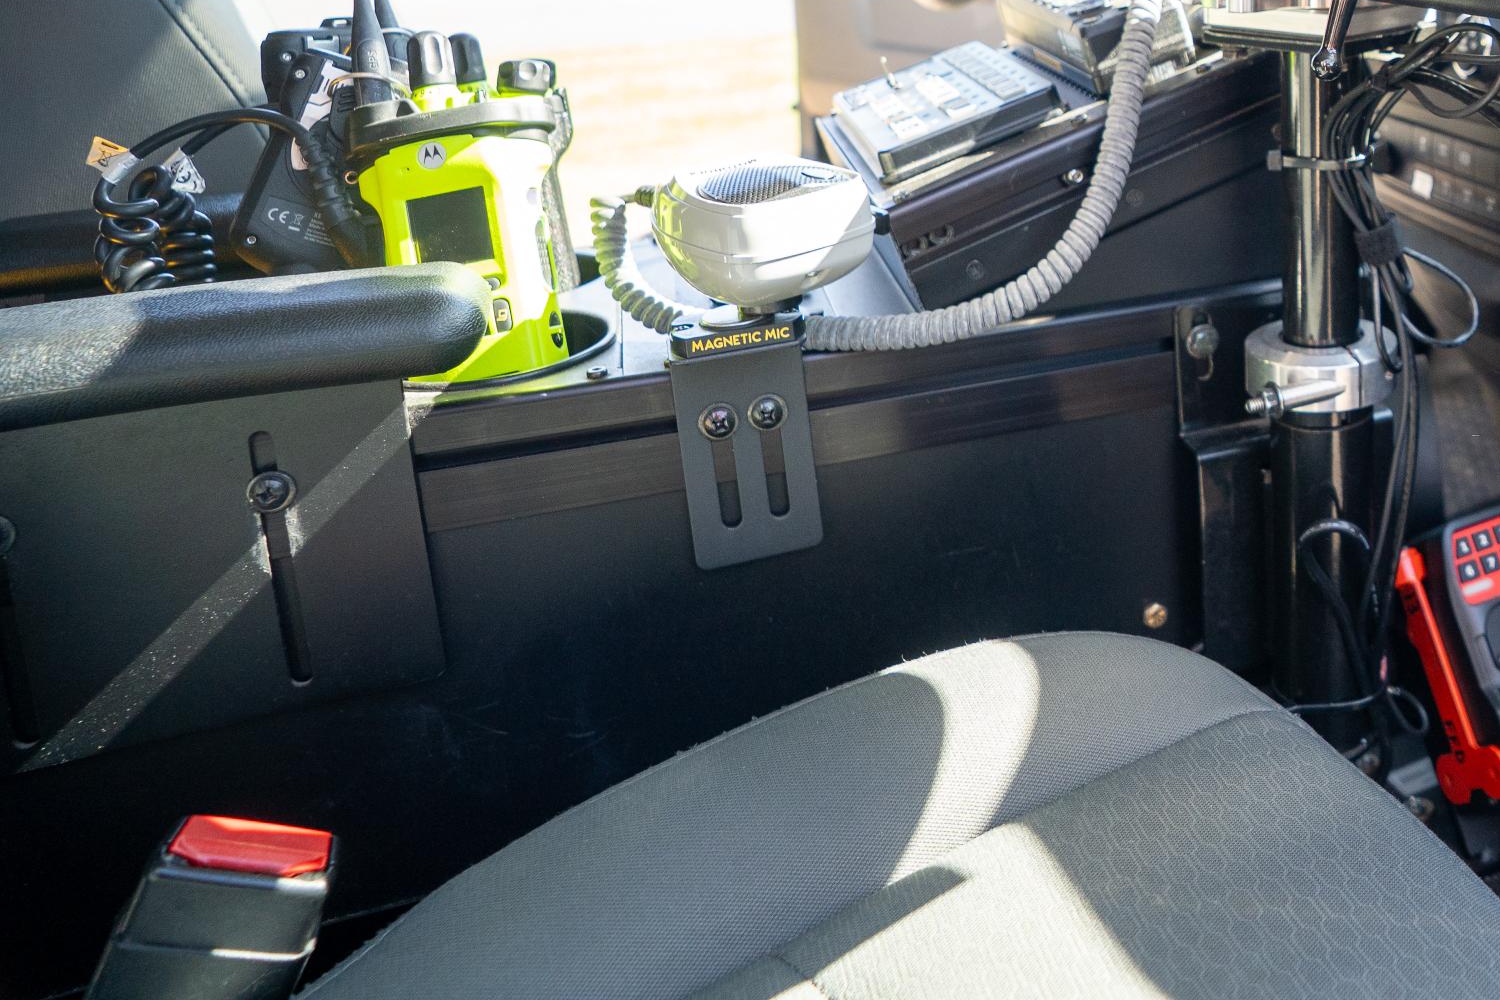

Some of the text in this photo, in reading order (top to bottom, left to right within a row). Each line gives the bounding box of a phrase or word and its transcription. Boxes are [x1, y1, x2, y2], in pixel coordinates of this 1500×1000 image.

[268, 207, 290, 224] CE
[691, 327, 790, 353] MAGNETIC MIC
